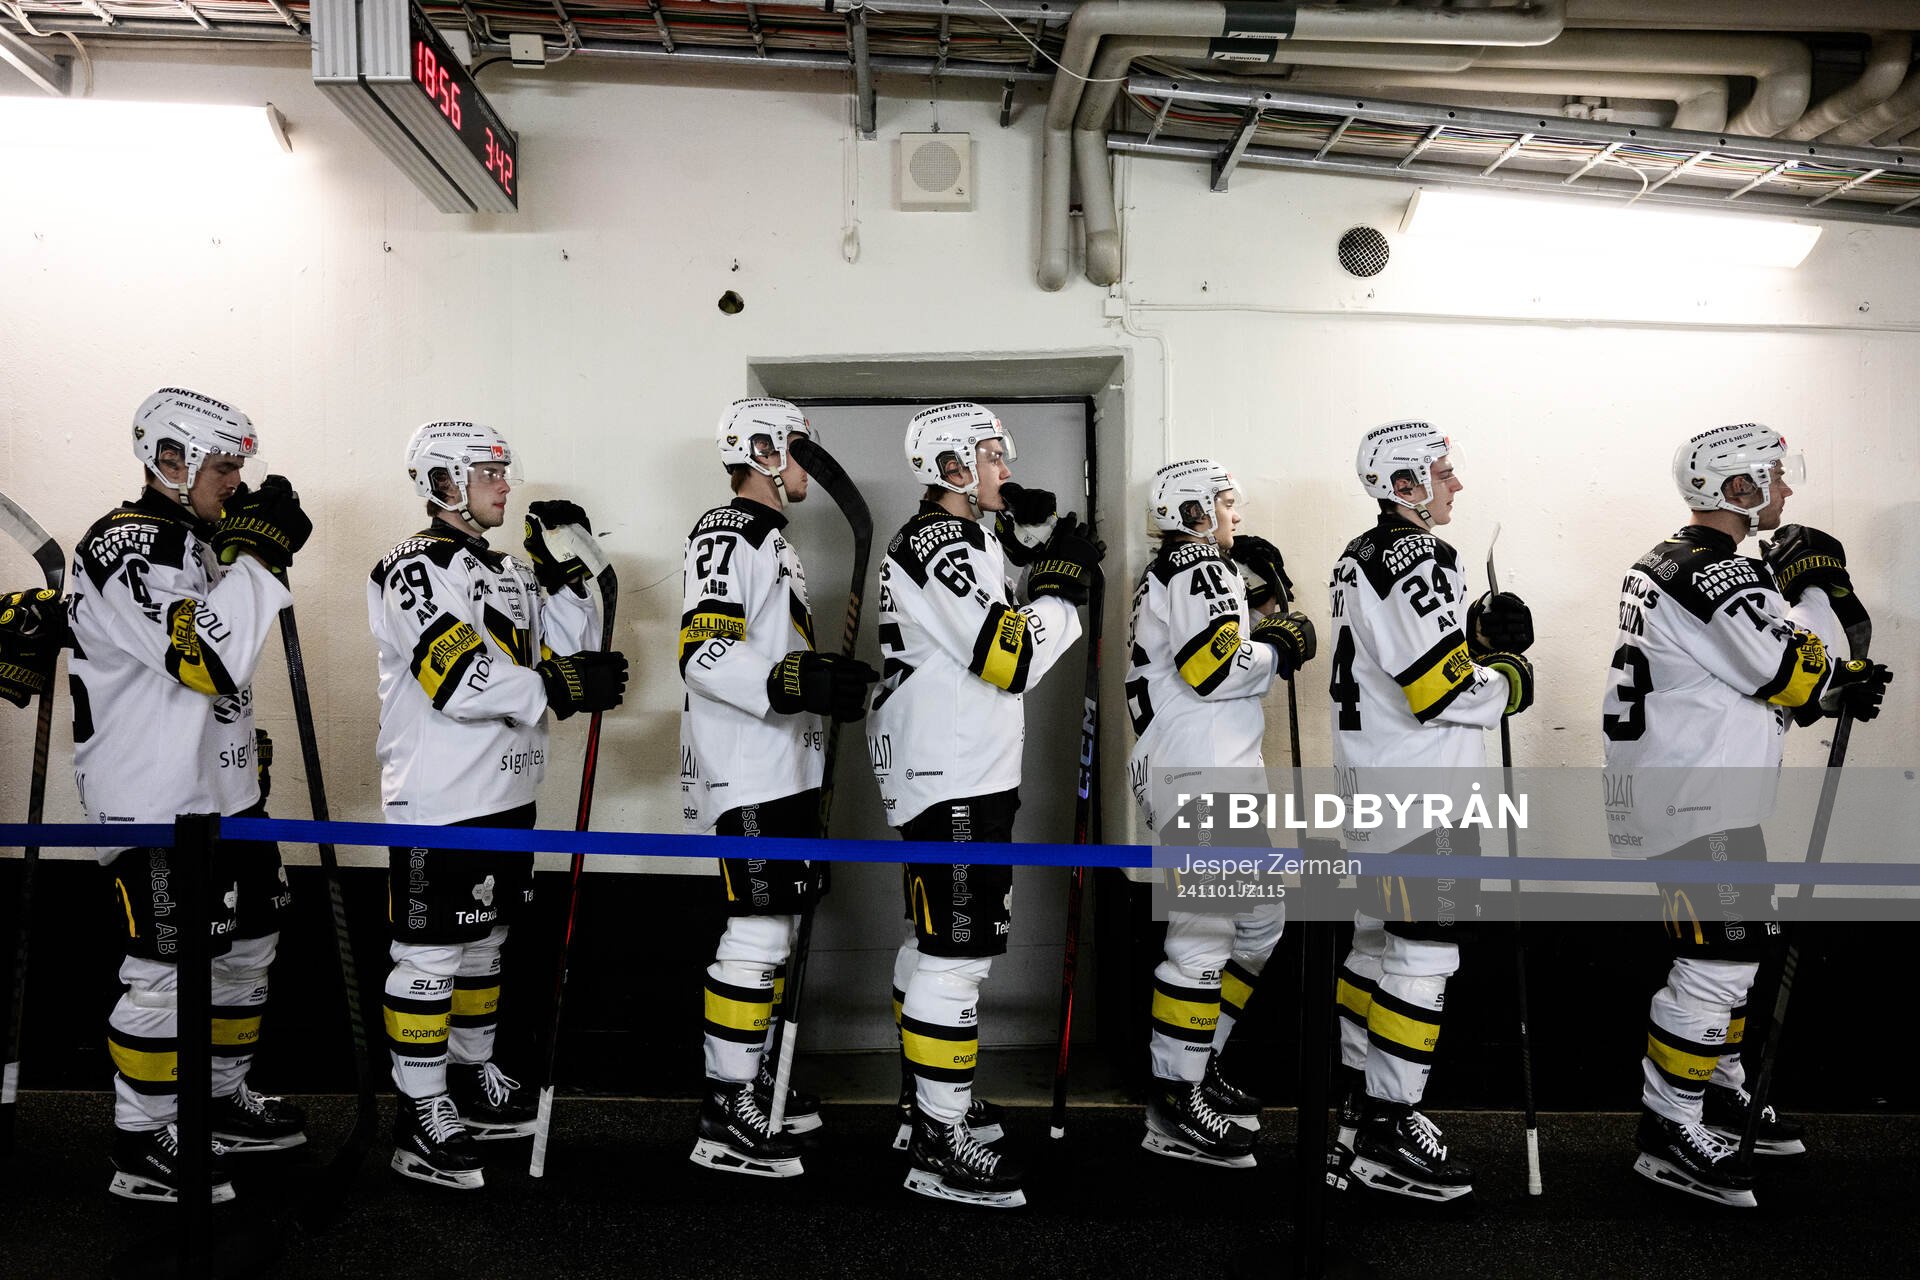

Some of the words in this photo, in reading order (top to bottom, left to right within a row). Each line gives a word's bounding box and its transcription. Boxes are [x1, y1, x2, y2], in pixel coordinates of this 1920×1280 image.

[202, 408, 223, 422] NEON
[914, 403, 973, 422] BRANTESTIG
[1367, 422, 1429, 441] BRANTESTIG
[1386, 436, 1403, 444] SKYLT
[1690, 422, 1757, 444] BRANTESTIG
[1709, 439, 1728, 449] SKYLT
[1734, 432, 1753, 441] NEON
[696, 535, 737, 581] 27
[917, 531, 964, 563] PARTNER
[1385, 538, 1437, 568] INDUSTRI
[390, 560, 433, 611] 39
[933, 547, 978, 598] 65
[1691, 557, 1750, 586] AROS
[1697, 566, 1756, 593] INDUSTRI
[701, 578, 728, 597] ABB
[1401, 563, 1455, 619] 24
[1706, 573, 1760, 601] PARTNER
[690, 617, 744, 634] ELLINGER
[1078, 697, 1096, 799] CCM
[750, 878, 770, 907] AB
[408, 898, 428, 930] AB
[951, 911, 972, 944] AB
[156, 922, 178, 955] AB
[726, 1124, 755, 1148] BAUER
[1398, 1147, 1428, 1166] BAUER
